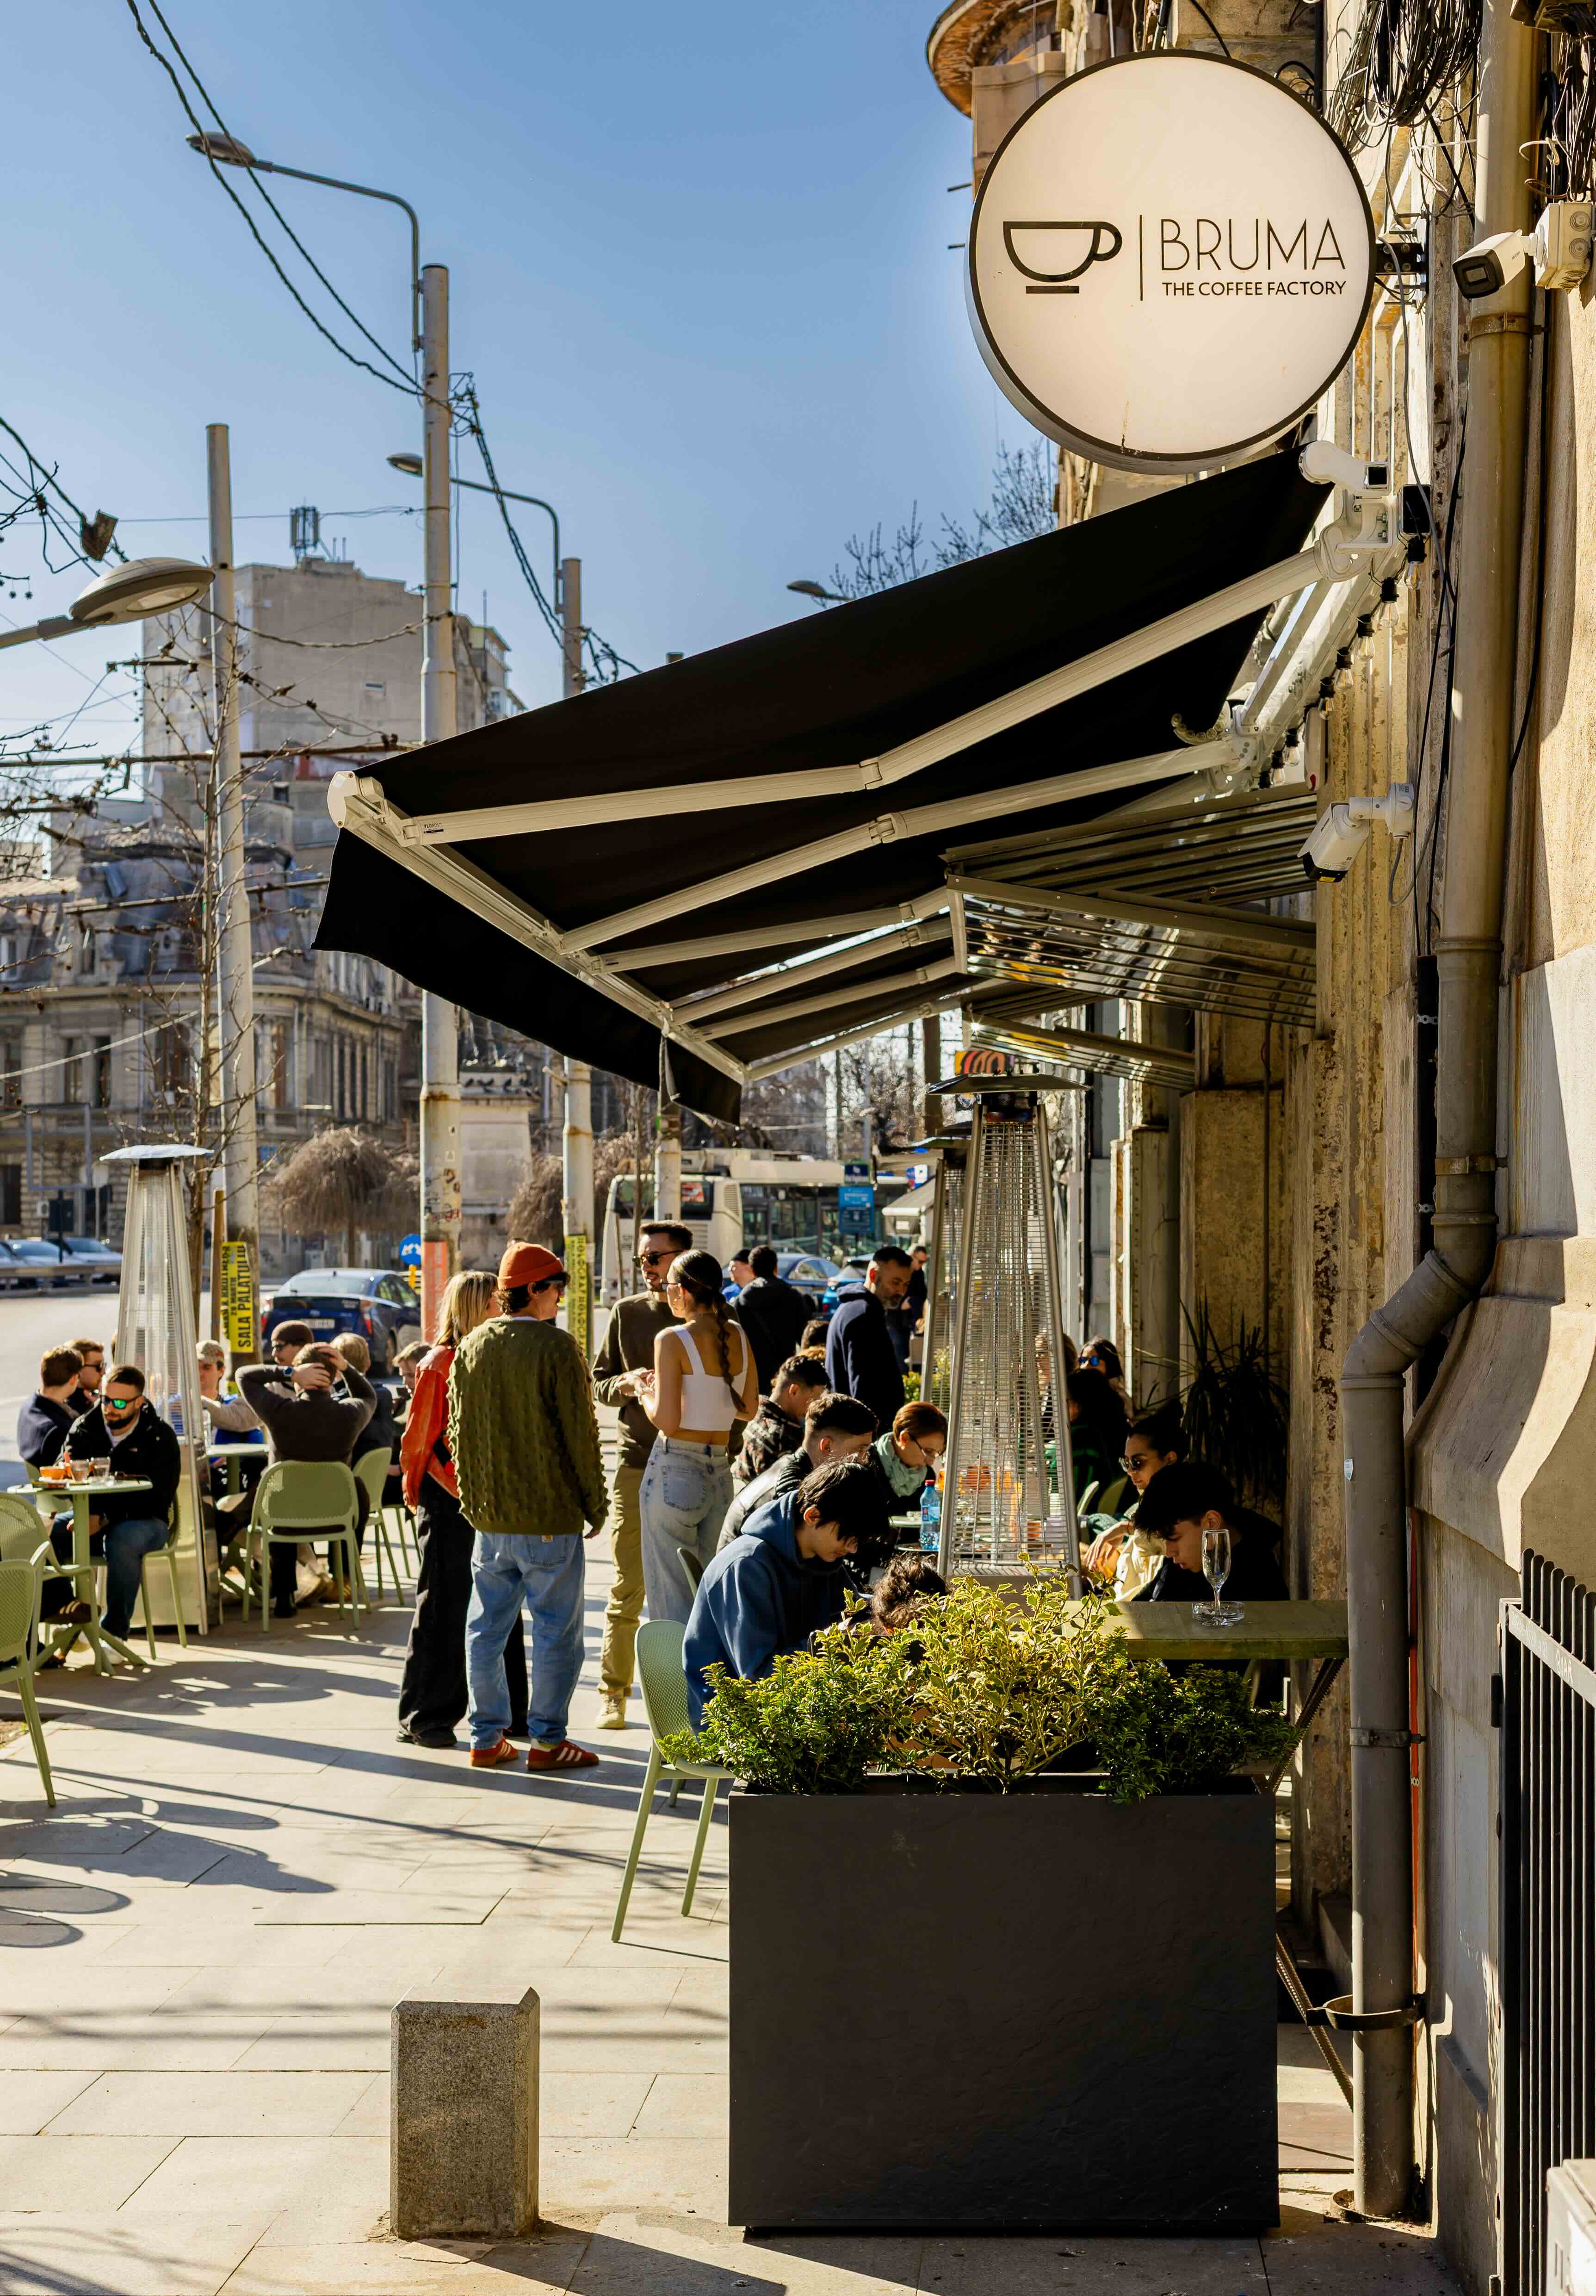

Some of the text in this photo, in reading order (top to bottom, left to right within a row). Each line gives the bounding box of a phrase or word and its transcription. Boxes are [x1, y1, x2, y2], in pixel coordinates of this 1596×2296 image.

[1161, 218, 1345, 270] BRUMA
[1162, 281, 1346, 296] THE COFFEE FACTORY
[238, 1316, 251, 1347] SALA
